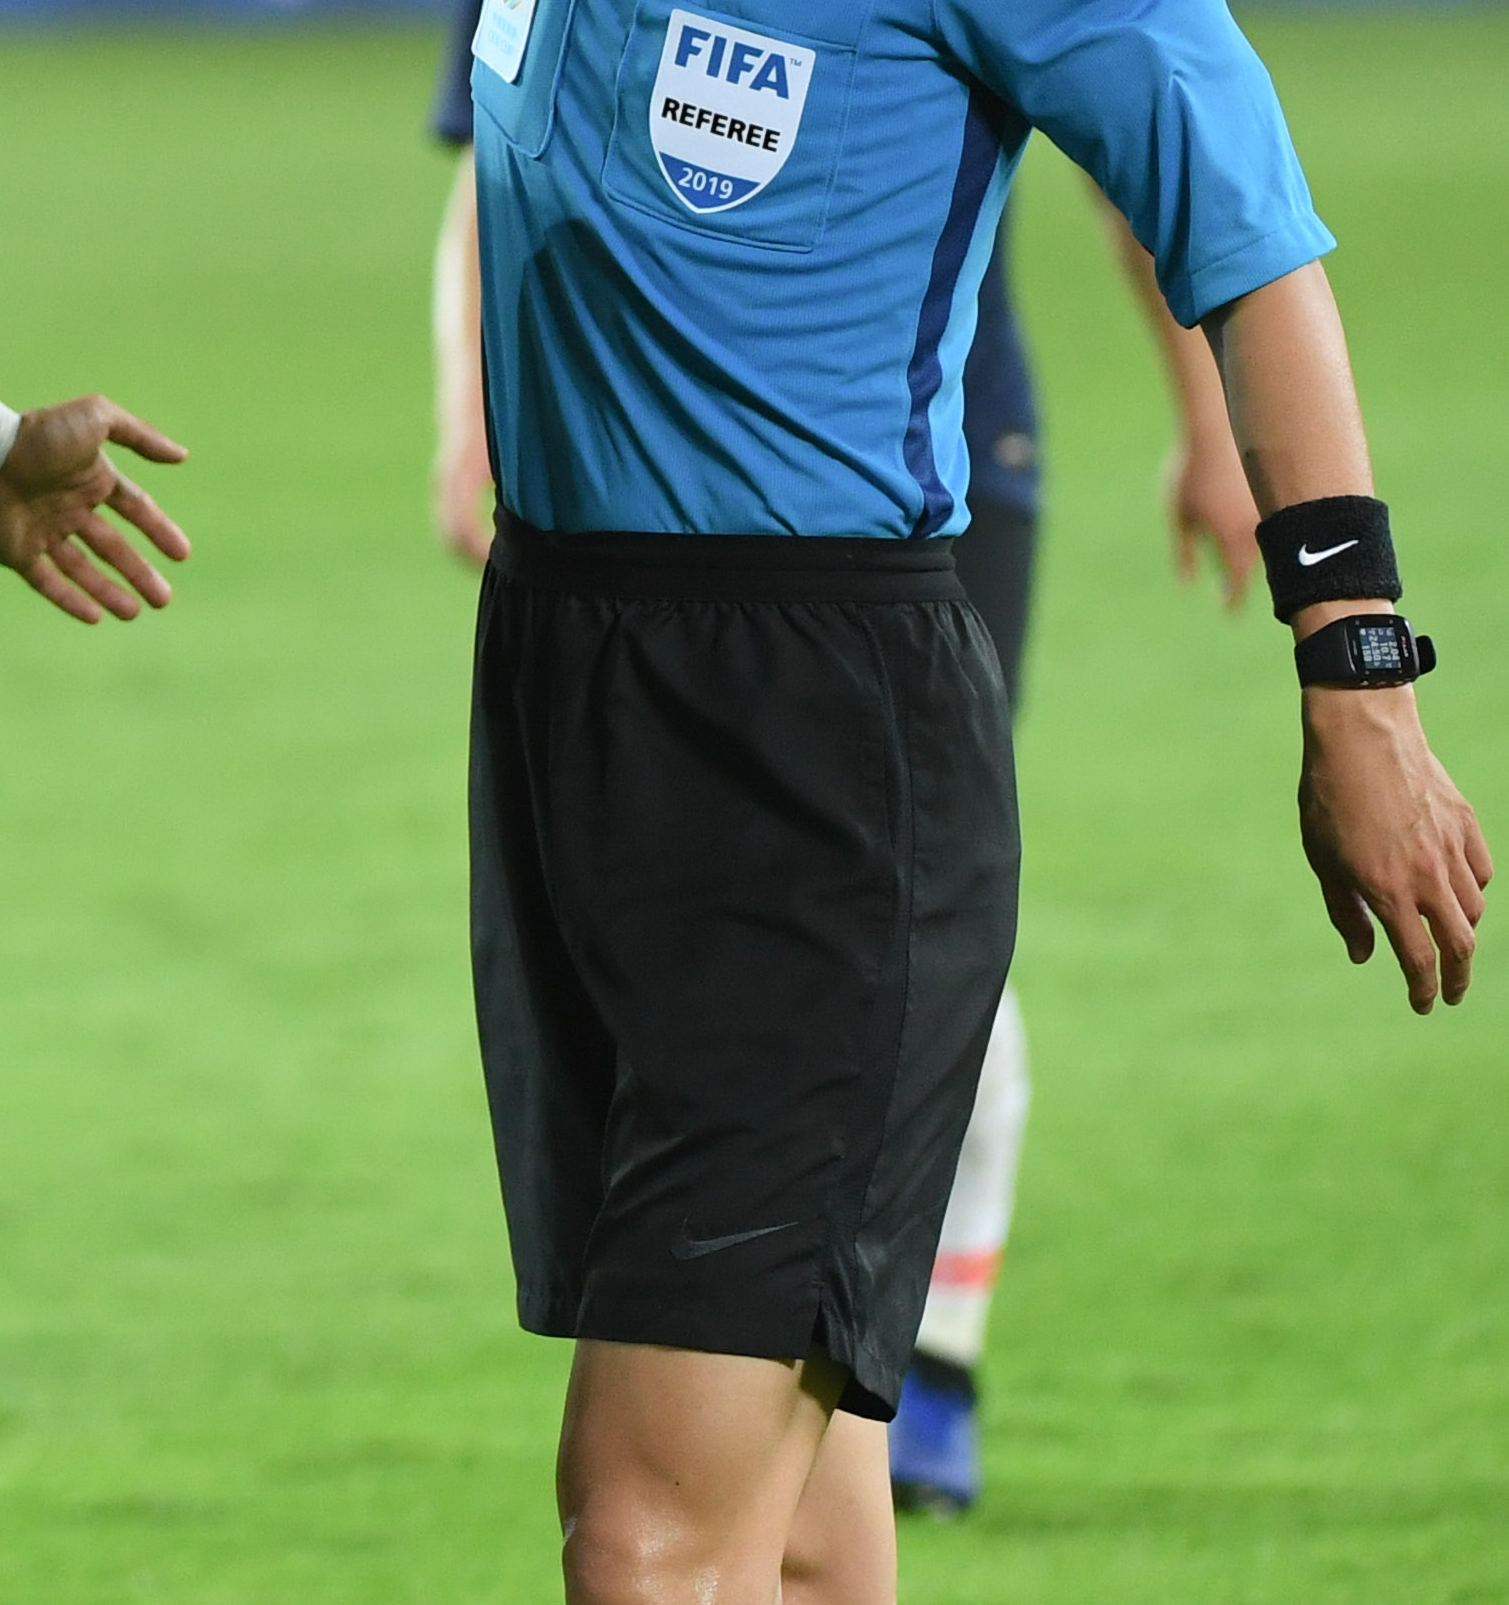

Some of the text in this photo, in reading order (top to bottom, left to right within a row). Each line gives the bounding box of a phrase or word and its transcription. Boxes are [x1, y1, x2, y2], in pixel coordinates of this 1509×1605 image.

[674, 25, 789, 99] FIFA
[661, 97, 780, 152] REFEREE
[678, 167, 733, 199] 2019
